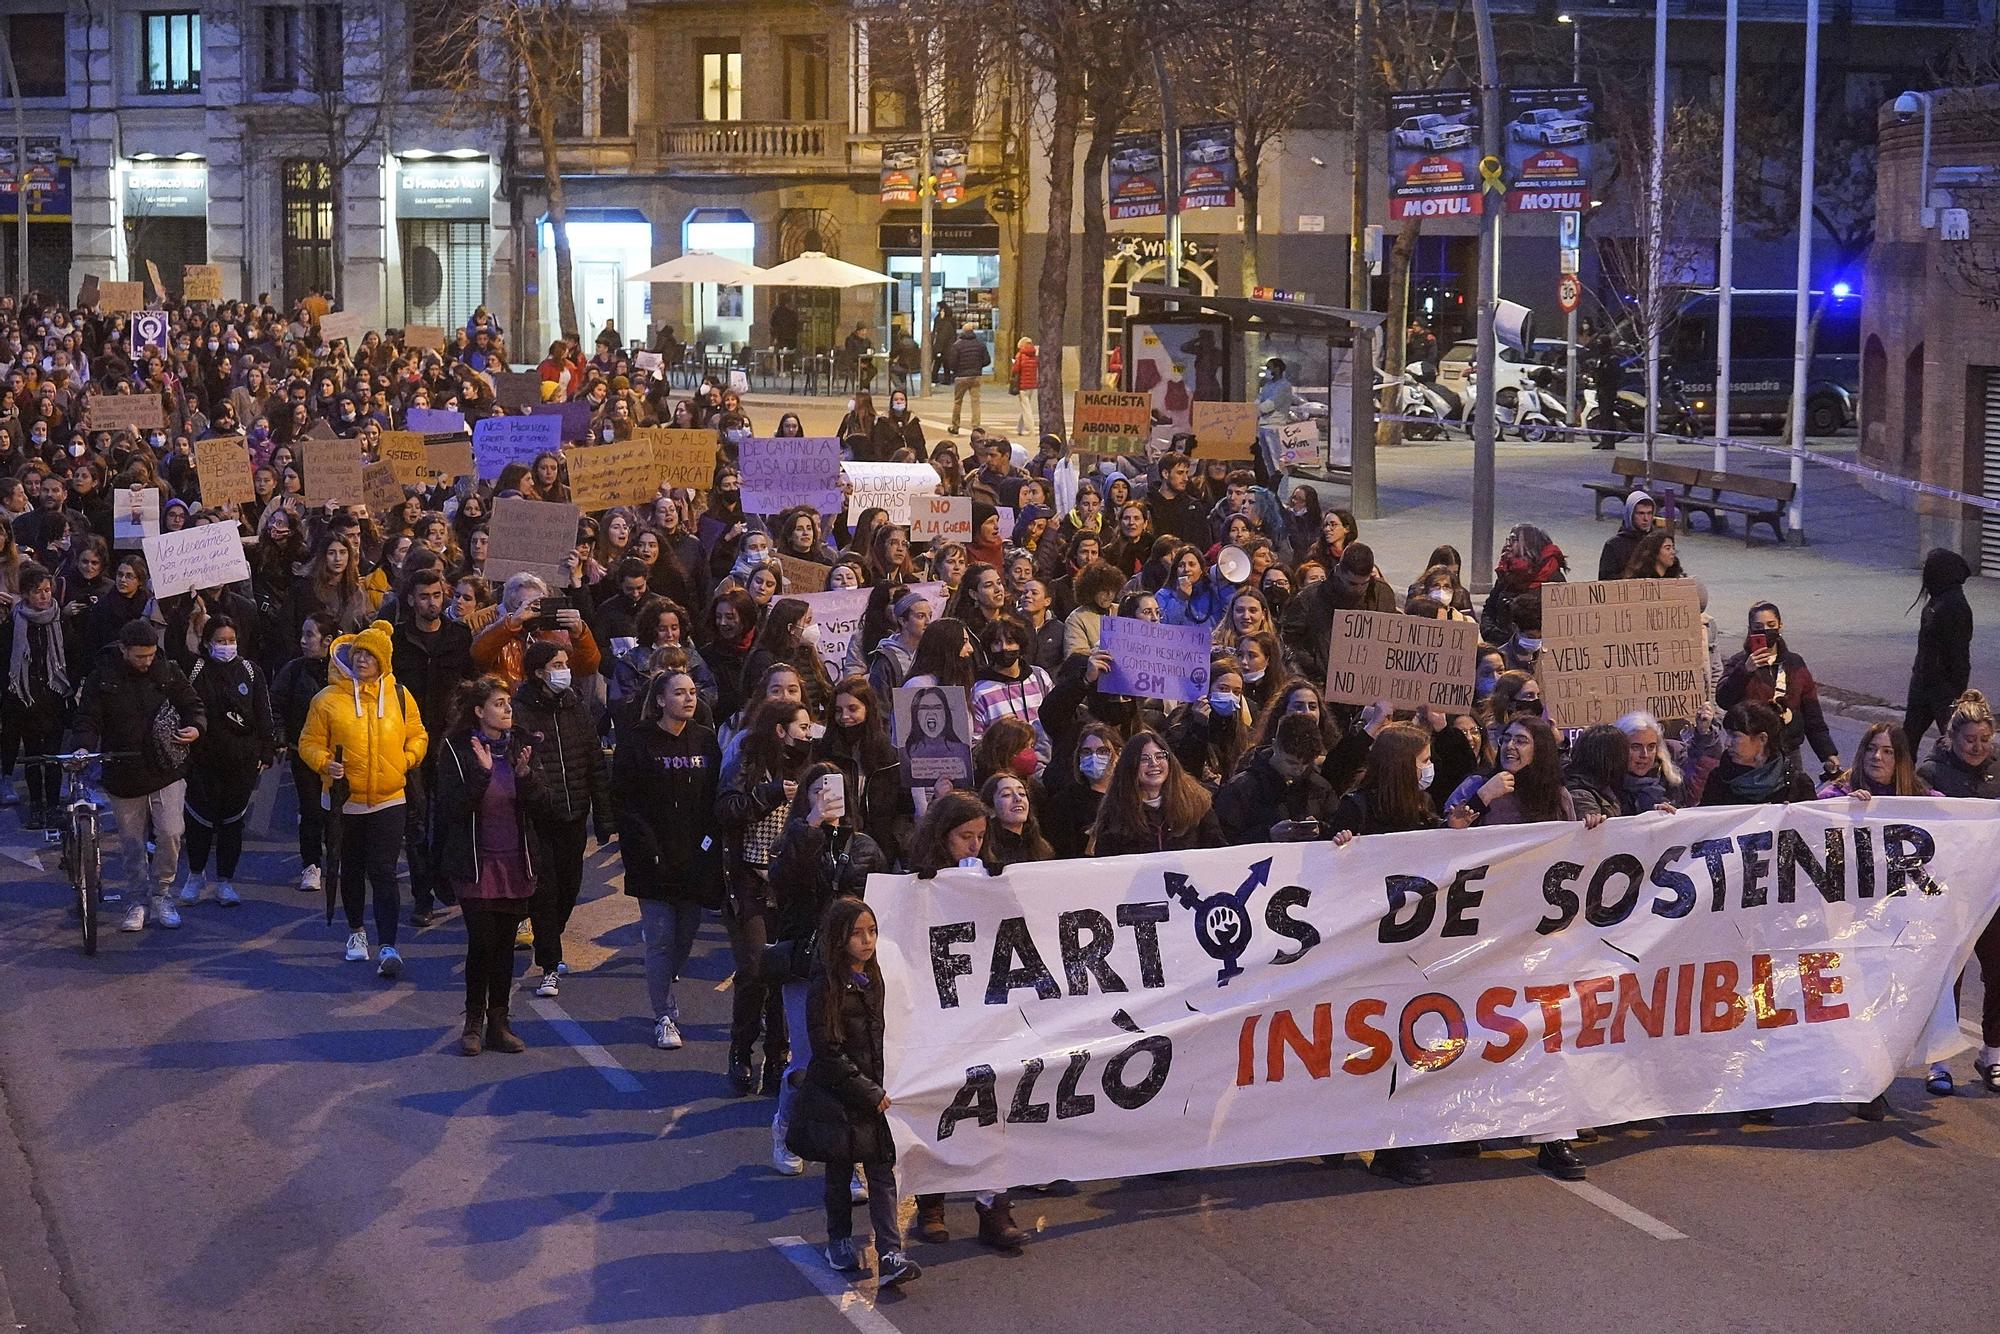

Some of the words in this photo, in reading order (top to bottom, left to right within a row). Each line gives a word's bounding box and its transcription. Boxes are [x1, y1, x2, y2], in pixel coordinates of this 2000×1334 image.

[1421, 164, 1449, 173] MOTUL
[1537, 159, 1565, 167] MOTUL
[1116, 203, 1161, 218] MOTUL
[1185, 194, 1227, 208] MOTUL
[1402, 197, 1472, 217] MOTUL
[1520, 192, 1582, 210] MOTUL
[1084, 394, 1145, 407] MACHISTA
[1082, 422, 1120, 433] ABONO
[681, 432, 708, 446] ALS
[743, 440, 761, 458] DE
[765, 439, 814, 456] CAMINO
[819, 440, 834, 454] A
[742, 458, 781, 477] CASA
[785, 457, 831, 475] QUIERO
[743, 478, 774, 493] SER
[820, 475, 840, 491] NO
[854, 476, 872, 493] DE
[852, 492, 905, 508] NOSOTRAS
[930, 500, 951, 513] NO
[912, 518, 922, 533] A
[927, 520, 940, 534] LA
[943, 520, 971, 534] GUERRA
[1550, 585, 1578, 607] AVUI
[1589, 584, 1607, 604] NO
[1618, 583, 1629, 602] HI
[1556, 611, 1601, 637] TOTES
[1614, 608, 1632, 634] LES
[1645, 605, 1690, 632] NOSTRES
[1123, 621, 1134, 635] MI
[1140, 623, 1174, 640] CUERPO
[1179, 631, 1185, 642] Y
[1192, 632, 1205, 645] MI
[1344, 613, 1373, 640] SOM
[1377, 618, 1403, 644] LES
[1407, 623, 1444, 648] NETES
[1450, 628, 1467, 650] DE
[1102, 638, 1151, 656] VESTUARIO
[1347, 644, 1369, 665] LES
[1385, 647, 1440, 675] BRUIXES
[1445, 655, 1464, 678] QUE
[1551, 647, 1591, 673] VEUS
[1603, 642, 1660, 669] JUNTES
[1134, 671, 1165, 694] 8M
[1334, 671, 1355, 694] NO
[1360, 674, 1382, 697] VAU
[1390, 677, 1423, 701] PODER
[1428, 681, 1472, 707] CREMAR
[1556, 677, 1582, 699] DES
[1605, 675, 1622, 696] DE
[1632, 674, 1649, 694] LA
[1653, 670, 1697, 692] TOMBA
[1556, 701, 1576, 725] NO
[1378, 864, 1490, 944] DE
[1535, 823, 1945, 936] SOSTENIR
[937, 1008, 1173, 1141] ALLÒ
[1236, 951, 1851, 1087] INSOSTENIBLE
